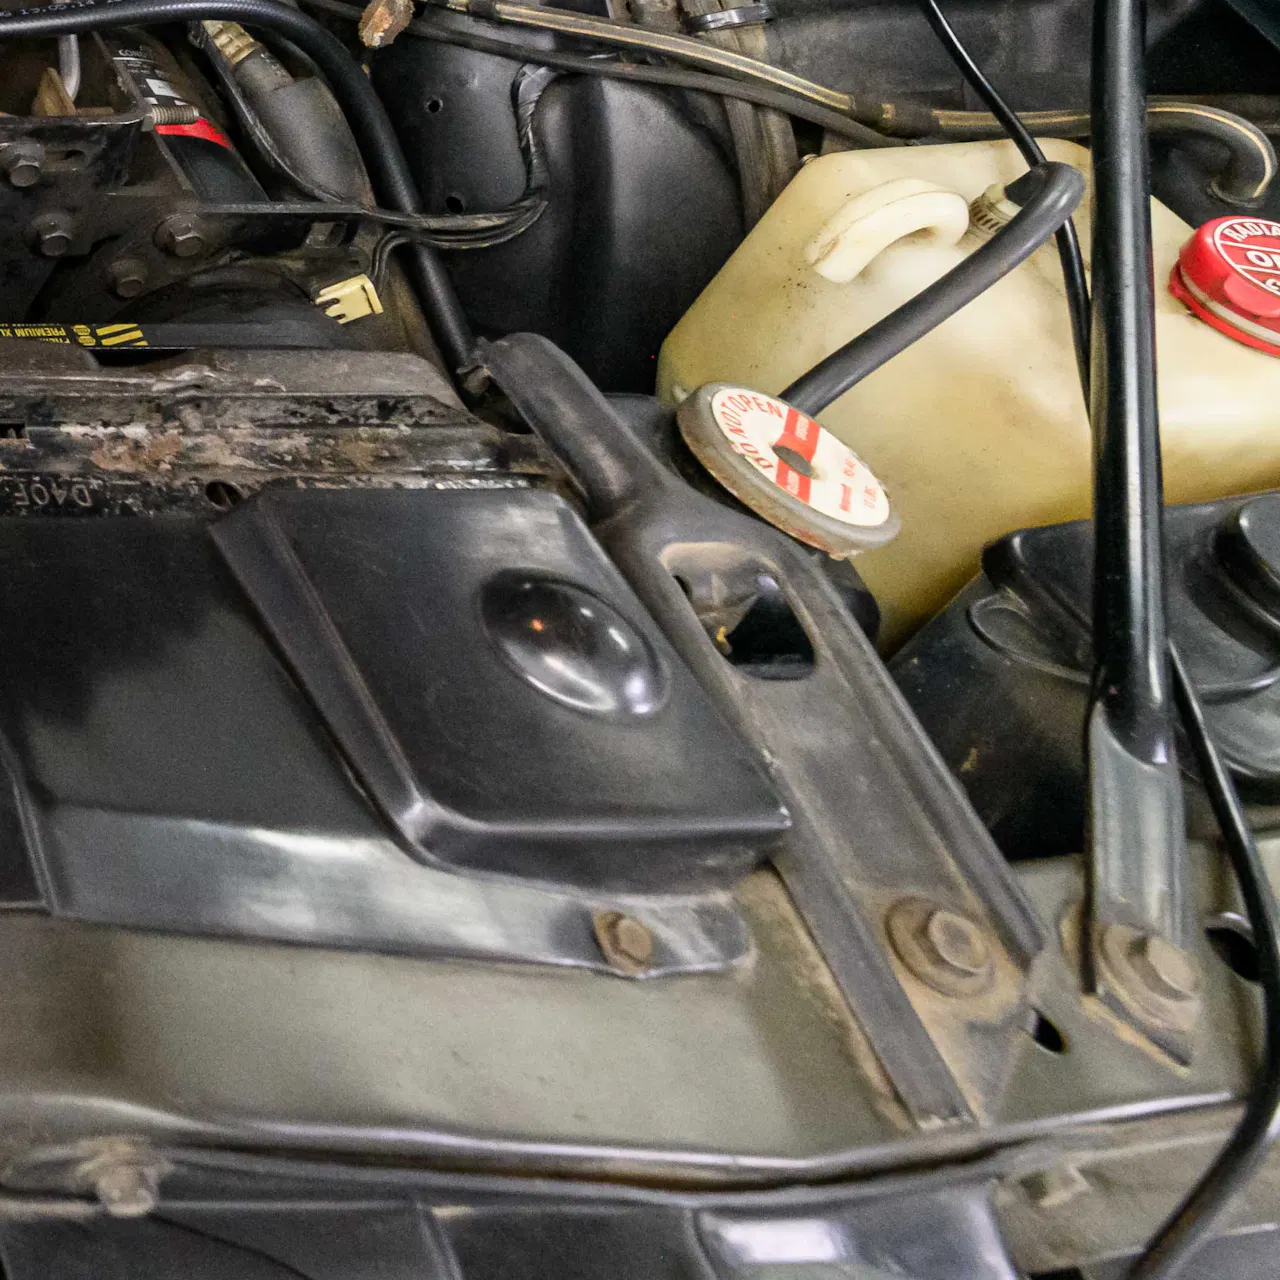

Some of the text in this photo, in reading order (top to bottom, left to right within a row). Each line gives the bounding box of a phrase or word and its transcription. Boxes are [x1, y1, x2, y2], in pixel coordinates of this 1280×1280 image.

[14, 327, 67, 337] PREMIUM
[728, 394, 785, 419] OPEN
[720, 401, 749, 439] NOT
